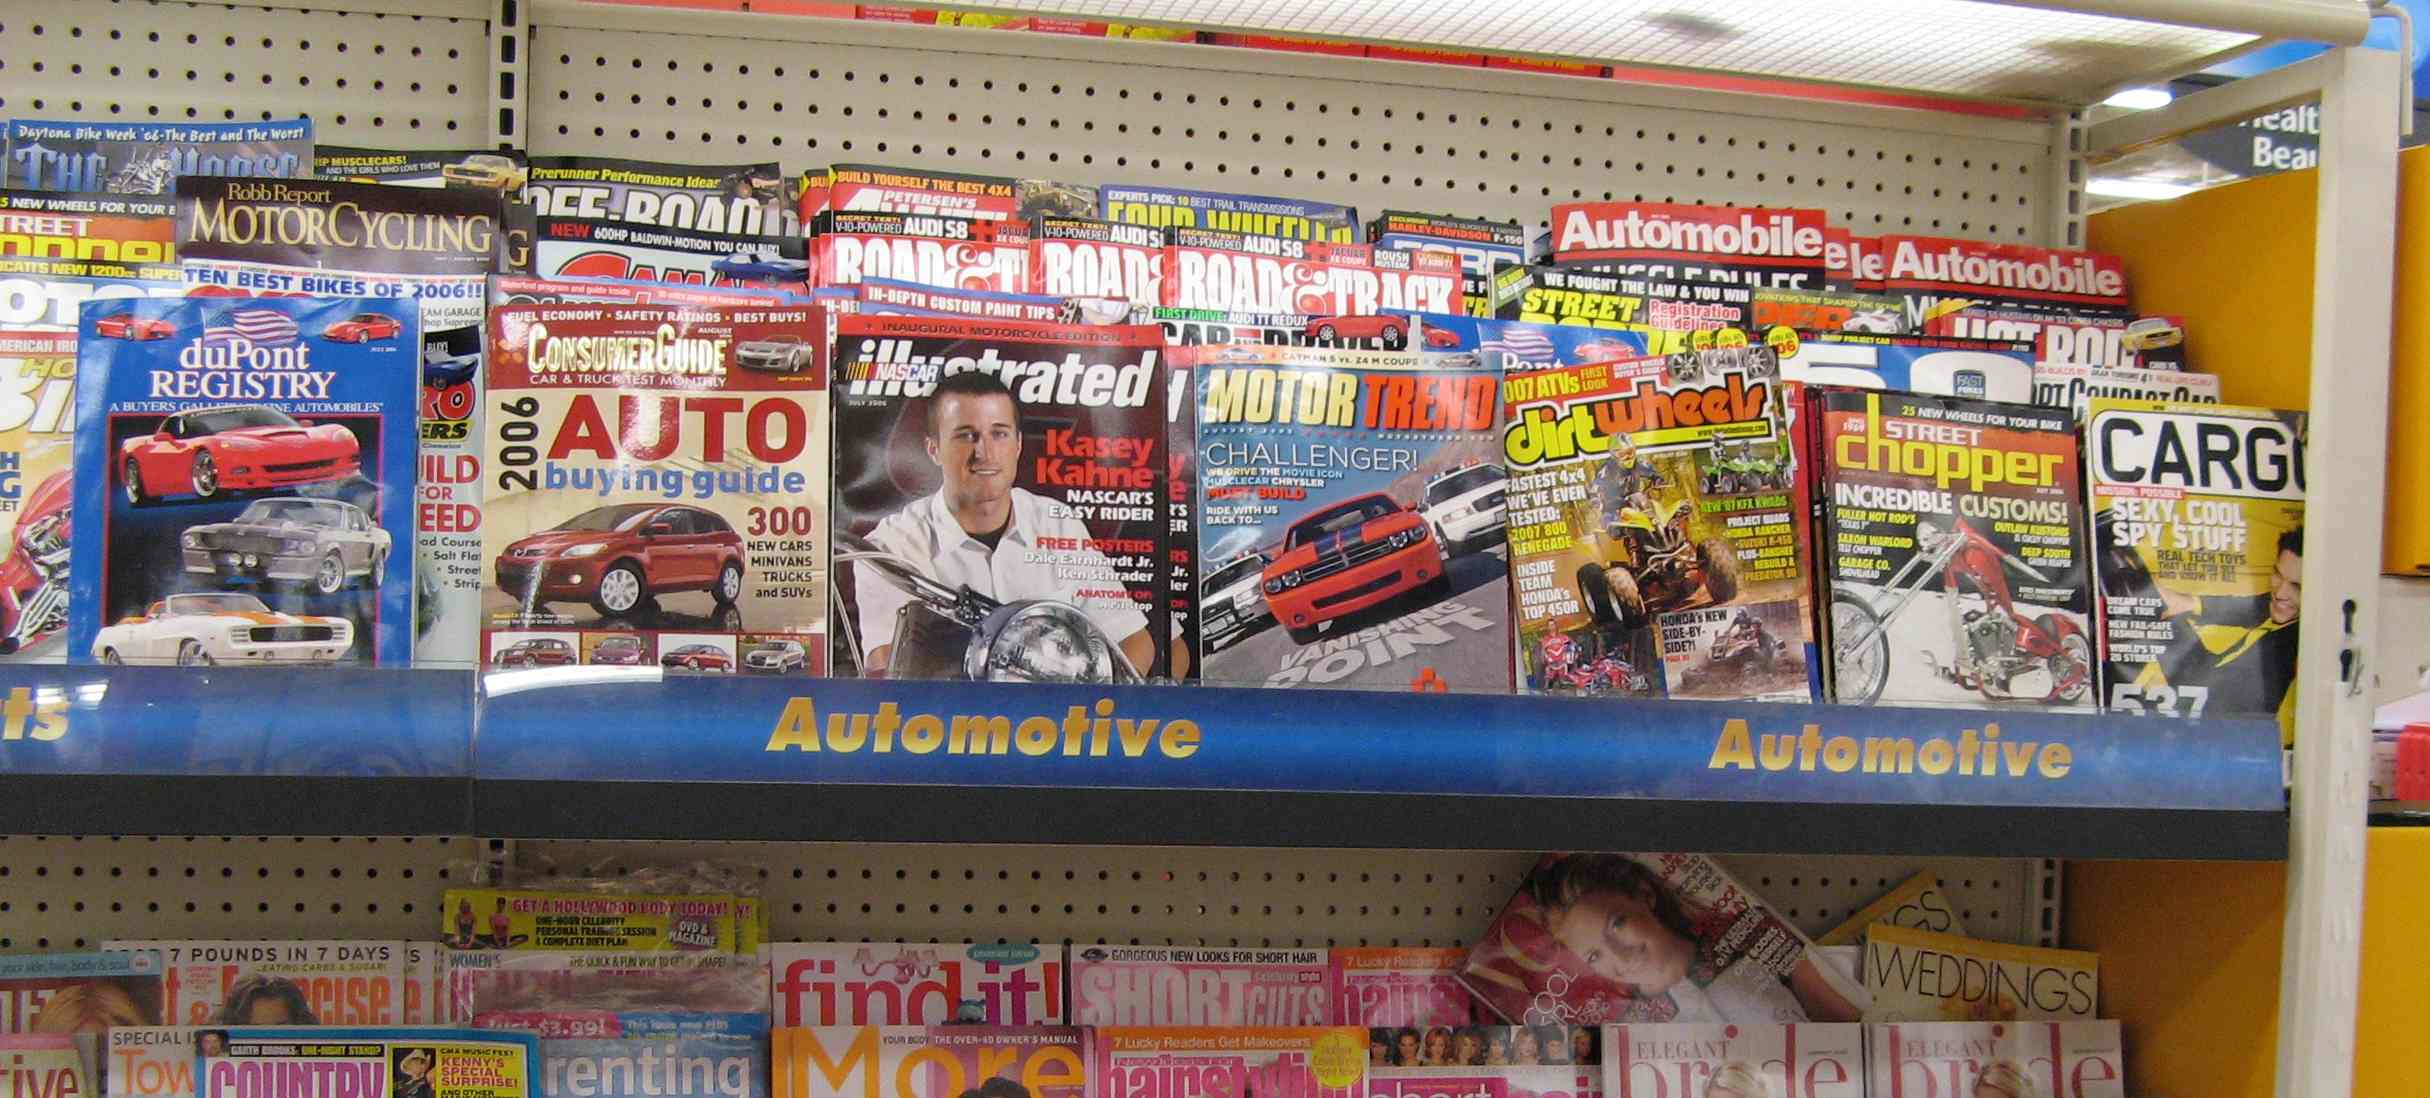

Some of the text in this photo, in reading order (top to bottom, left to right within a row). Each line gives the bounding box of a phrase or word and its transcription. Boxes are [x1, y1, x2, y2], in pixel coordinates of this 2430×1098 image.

[19, 124, 305, 142] Daytona Bike Week Best and The Worst
[531, 166, 685, 187] Prerunner Performance
[838, 171, 985, 195] BUILD YOURSELF THE BEST
[228, 182, 331, 204] Robb Report
[12, 198, 168, 216] NEW WHEELS FOR YOUR
[1239, 200, 1305, 217] TRANSMISSIONS
[191, 198, 491, 254] MOTORCYCLING
[903, 218, 969, 240] AUDI S8
[1111, 225, 1150, 247] AUDI
[1388, 221, 1492, 242] HARLEY-DAVIDSON
[1559, 209, 1825, 258] Automobile
[551, 223, 757, 253] NEW 600HP BALDWIN-MOTION YOU CAN
[1244, 236, 1304, 259] AUDI S8
[1889, 240, 2122, 298] Automobile
[184, 268, 228, 285] TEN
[239, 271, 293, 291] BEST
[301, 277, 367, 297] BIKES
[381, 282, 405, 298] OF
[1544, 272, 1565, 287] WE
[1567, 274, 1618, 293] FOUGHT
[1620, 279, 1646, 295] THE
[1648, 282, 1677, 298] LAW
[1679, 285, 1691, 299] &
[1693, 285, 1720, 301] YOU
[1723, 287, 1750, 303] WIN
[508, 310, 807, 323] FUEL ECONOMY SAFETY BEST BUYS!
[930, 294, 1055, 320] CUSTOM PAINT TIPS
[1522, 288, 1643, 326] STREET
[1649, 301, 1740, 321] Registration
[882, 322, 965, 336] INAUGURAL
[179, 337, 311, 371] duPont
[531, 373, 559, 385] CAR
[875, 363, 941, 383] NASCAR
[149, 371, 337, 400] REGISTRY
[1537, 372, 1580, 399] ATVs
[123, 401, 176, 413] BUYERS
[1203, 368, 1498, 432] MOTOR TREND
[1918, 406, 2038, 429] NEW WHEELS FOR YOUR
[547, 394, 807, 464] AUTO
[1504, 404, 1612, 467] dirt
[1885, 418, 1982, 447] STREET
[499, 396, 541, 491] 2006
[1045, 427, 1154, 468] Kasey
[1835, 393, 2066, 493] chopper
[1205, 442, 1419, 473] CHALLENGER!
[2101, 417, 2306, 497] CARG
[545, 461, 806, 499] buying guide
[1035, 457, 1154, 489] Kahne
[1271, 477, 1326, 489] CHRYSLER
[1505, 471, 1557, 492] FASTEST
[1067, 488, 1155, 505] NASCAR'S
[1507, 485, 1587, 508] WE'VE EVER
[1835, 483, 2068, 525] INCREDIBLE CUSTOMS!
[747, 505, 812, 536] 300
[1047, 505, 1155, 521] EASY RIDER
[1206, 505, 1279, 516] RIDE WITH US
[1206, 515, 1235, 526] BACK
[1508, 507, 1561, 526] TESTED:
[2187, 500, 2246, 527] COOL
[1511, 523, 1542, 541] 2007
[2112, 522, 2248, 553] SPY STUFF
[747, 541, 813, 552] NEW CARS
[1036, 536, 1154, 554] FREE POSTERS
[1514, 535, 1573, 557] RENEGADE
[751, 556, 813, 568] MINIVANS
[1024, 551, 1154, 569] Dale Earnhardt Jr.
[1838, 558, 1870, 570] GARAGE
[2158, 550, 2185, 563] REAL
[761, 571, 813, 583] TRUCKS
[1516, 559, 1557, 577] INSIDE
[755, 586, 813, 599] and SUVs
[1518, 575, 1553, 592] TEAM
[1523, 603, 1548, 620] TOP
[1705, 609, 1728, 623] NEW
[765, 697, 1201, 759] Automotive
[1708, 718, 2074, 779] Automotive
[512, 900, 638, 915] GET HOLLYWOOD
[581, 916, 625, 927] CELEBRITY
[191, 946, 391, 962] POUNDS IN DAYS
[1111, 950, 1318, 964] GORGEOUS NEW LOOKS FOR SHORT HAIR
[1871, 942, 2093, 1015] WEDDINGS
[777, 959, 1060, 1027] find it!
[113, 1031, 183, 1047] SPECIAL
[1162, 1037, 1216, 1049] Readers
[1906, 1040, 1999, 1058] ELEGANT
[1637, 1040, 1732, 1061] ELEGANT
[441, 1057, 505, 1069] KENNY'S
[441, 1066, 500, 1078] SPECIAL
[545, 1043, 752, 1098] renting
[441, 1076, 518, 1090] SURPRISE!
